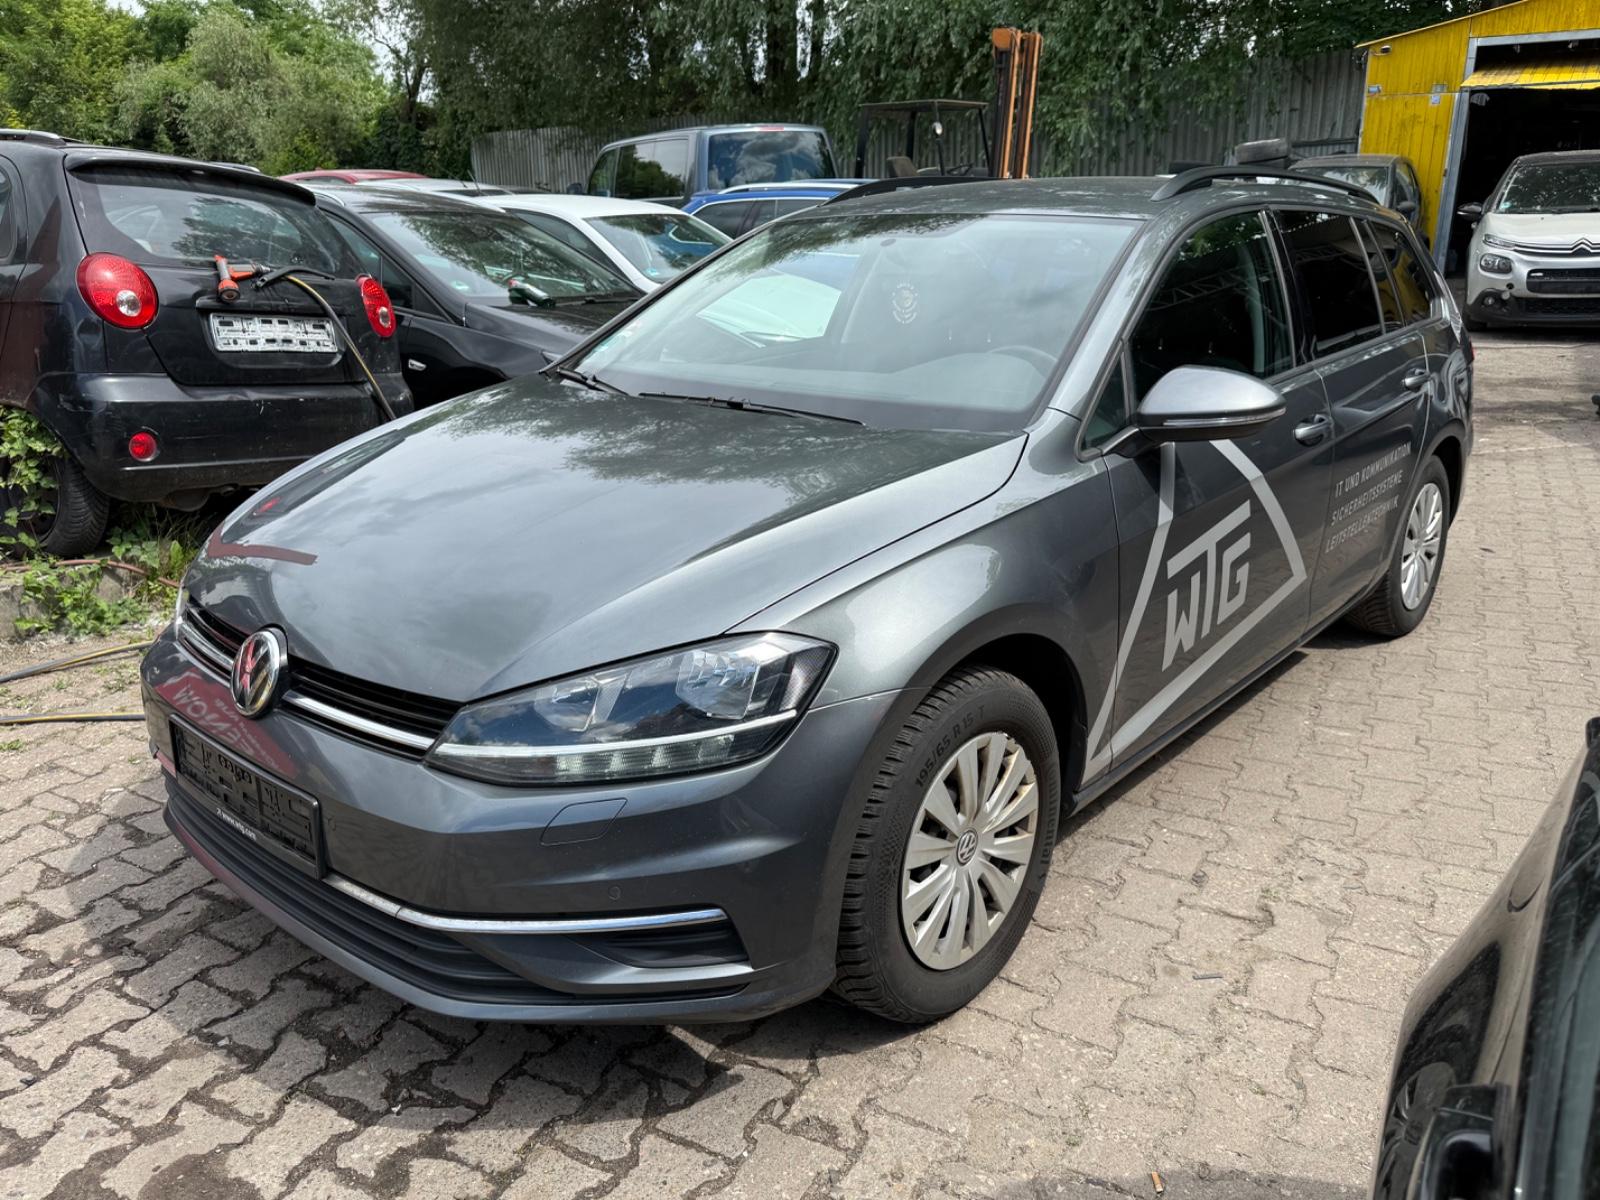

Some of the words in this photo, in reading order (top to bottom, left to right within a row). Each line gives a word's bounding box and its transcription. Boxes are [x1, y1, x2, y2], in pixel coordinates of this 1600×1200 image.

[1331, 469, 1404, 527] SICHERHEITSSYSTEME
[1335, 480, 1344, 498] IT
[1345, 472, 1360, 492] UND
[1361, 441, 1412, 484] KOMMUNIKATION
[1162, 499, 1251, 672] WTG
[915, 734, 951, 787] 195/65
[952, 722, 961, 739] R
